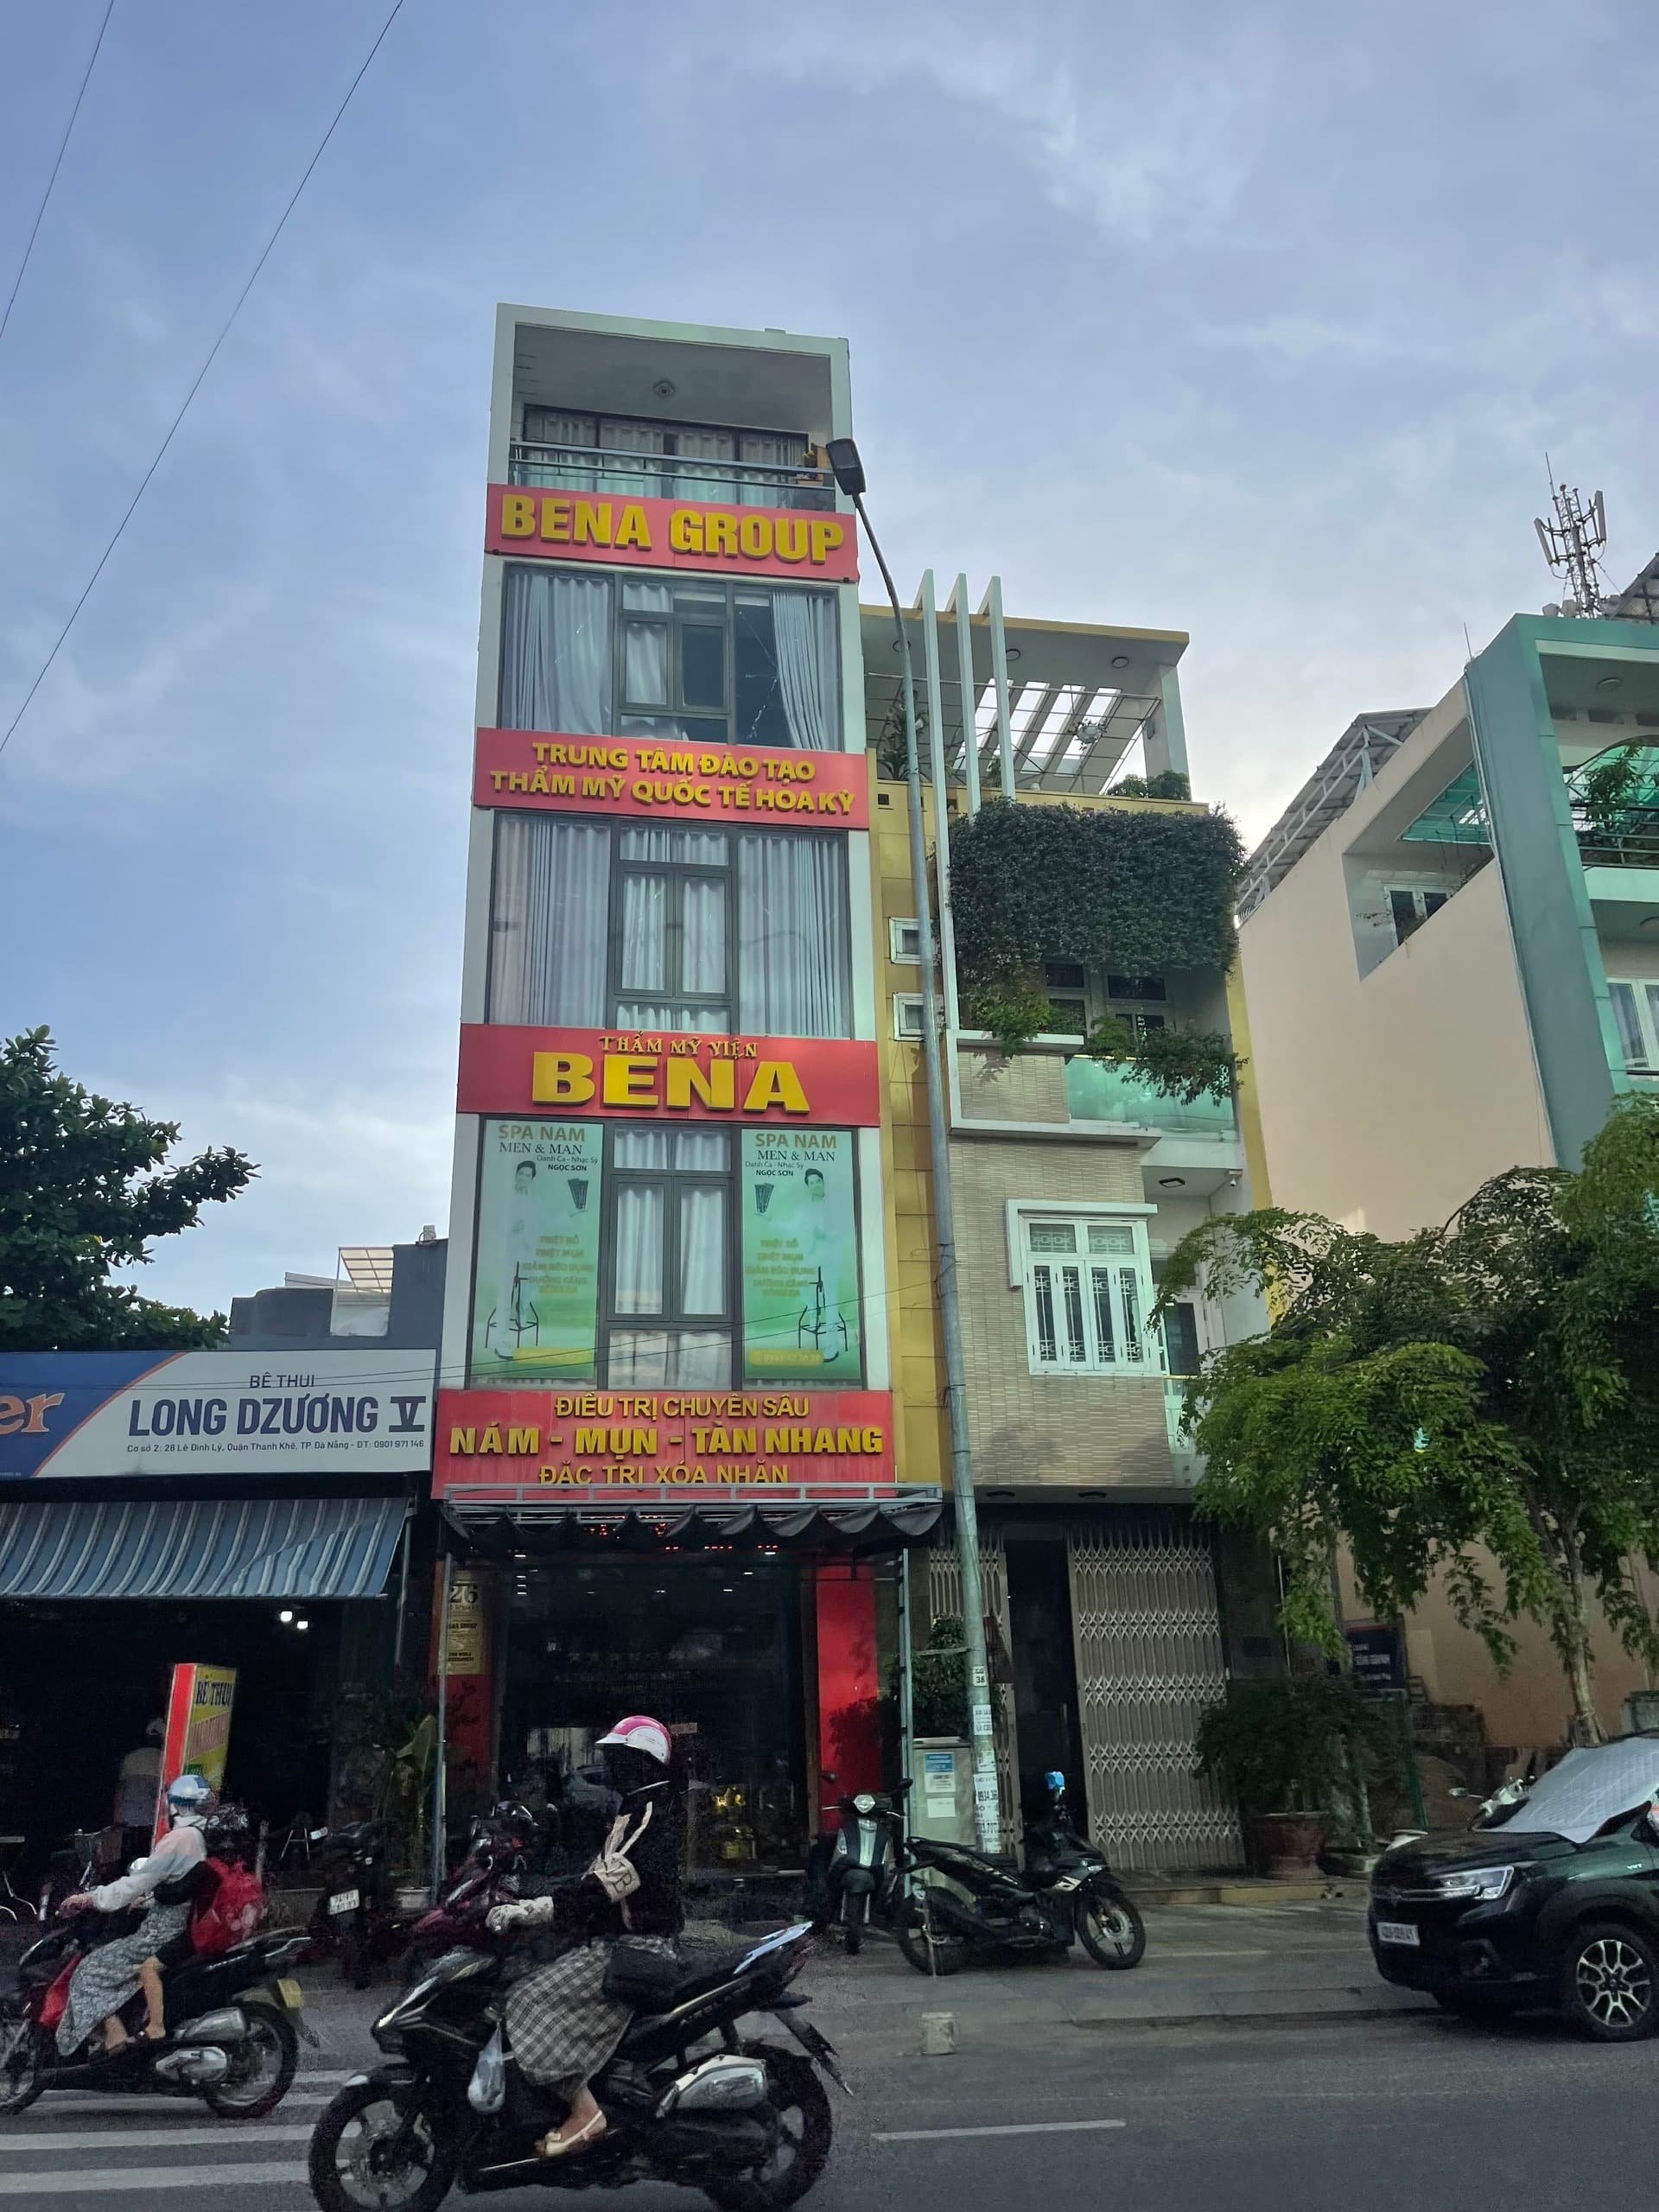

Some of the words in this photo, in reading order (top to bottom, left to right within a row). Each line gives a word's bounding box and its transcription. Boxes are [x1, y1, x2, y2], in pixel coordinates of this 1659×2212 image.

[500, 493, 652, 550] BENA
[670, 509, 843, 563] GROUP
[532, 742, 628, 769] TRUNG
[635, 747, 694, 775] TÂM
[699, 752, 759, 778] ĐÀO
[763, 759, 815, 786] TẠO
[490, 765, 575, 796] THẨM
[582, 774, 626, 799] MỸ
[632, 777, 712, 806] QUỐC
[718, 780, 753, 808] TẾ
[756, 788, 815, 814] HOA
[599, 1030, 663, 1054] THẨM
[671, 1037, 702, 1055] MỸ
[708, 1039, 758, 1059] VIỆN
[531, 1052, 810, 1114] BENA
[498, 1124, 533, 1140] SPA
[540, 1126, 585, 1141] NAM
[755, 1133, 789, 1147] SPA
[794, 1134, 836, 1148] NAM
[499, 1141, 531, 1153] MEN
[535, 1143, 544, 1154] &
[550, 1143, 582, 1154] MAN
[757, 1150, 787, 1160] MEN
[791, 1151, 800, 1160] &
[804, 1151, 835, 1161] MAN
[250, 1372, 272, 1388] BÊ
[276, 1375, 315, 1387] THUI
[129, 1397, 227, 1436] LONG
[237, 1393, 378, 1434] DZƯƠNG
[389, 1395, 426, 1432] V
[556, 1391, 613, 1417] ĐIỀU
[619, 1396, 657, 1421] TRỊ
[663, 1393, 758, 1417] CHUYÊN
[763, 1393, 810, 1417] SÂU
[251, 1442, 277, 1451] Thanh
[449, 1421, 540, 1454] NÁM
[575, 1427, 658, 1460] MỤN
[691, 1421, 758, 1454] TÀN
[765, 1427, 883, 1454] NHANG
[656, 1459, 708, 1484] XÓA
[717, 1459, 788, 1484] NHĂN
